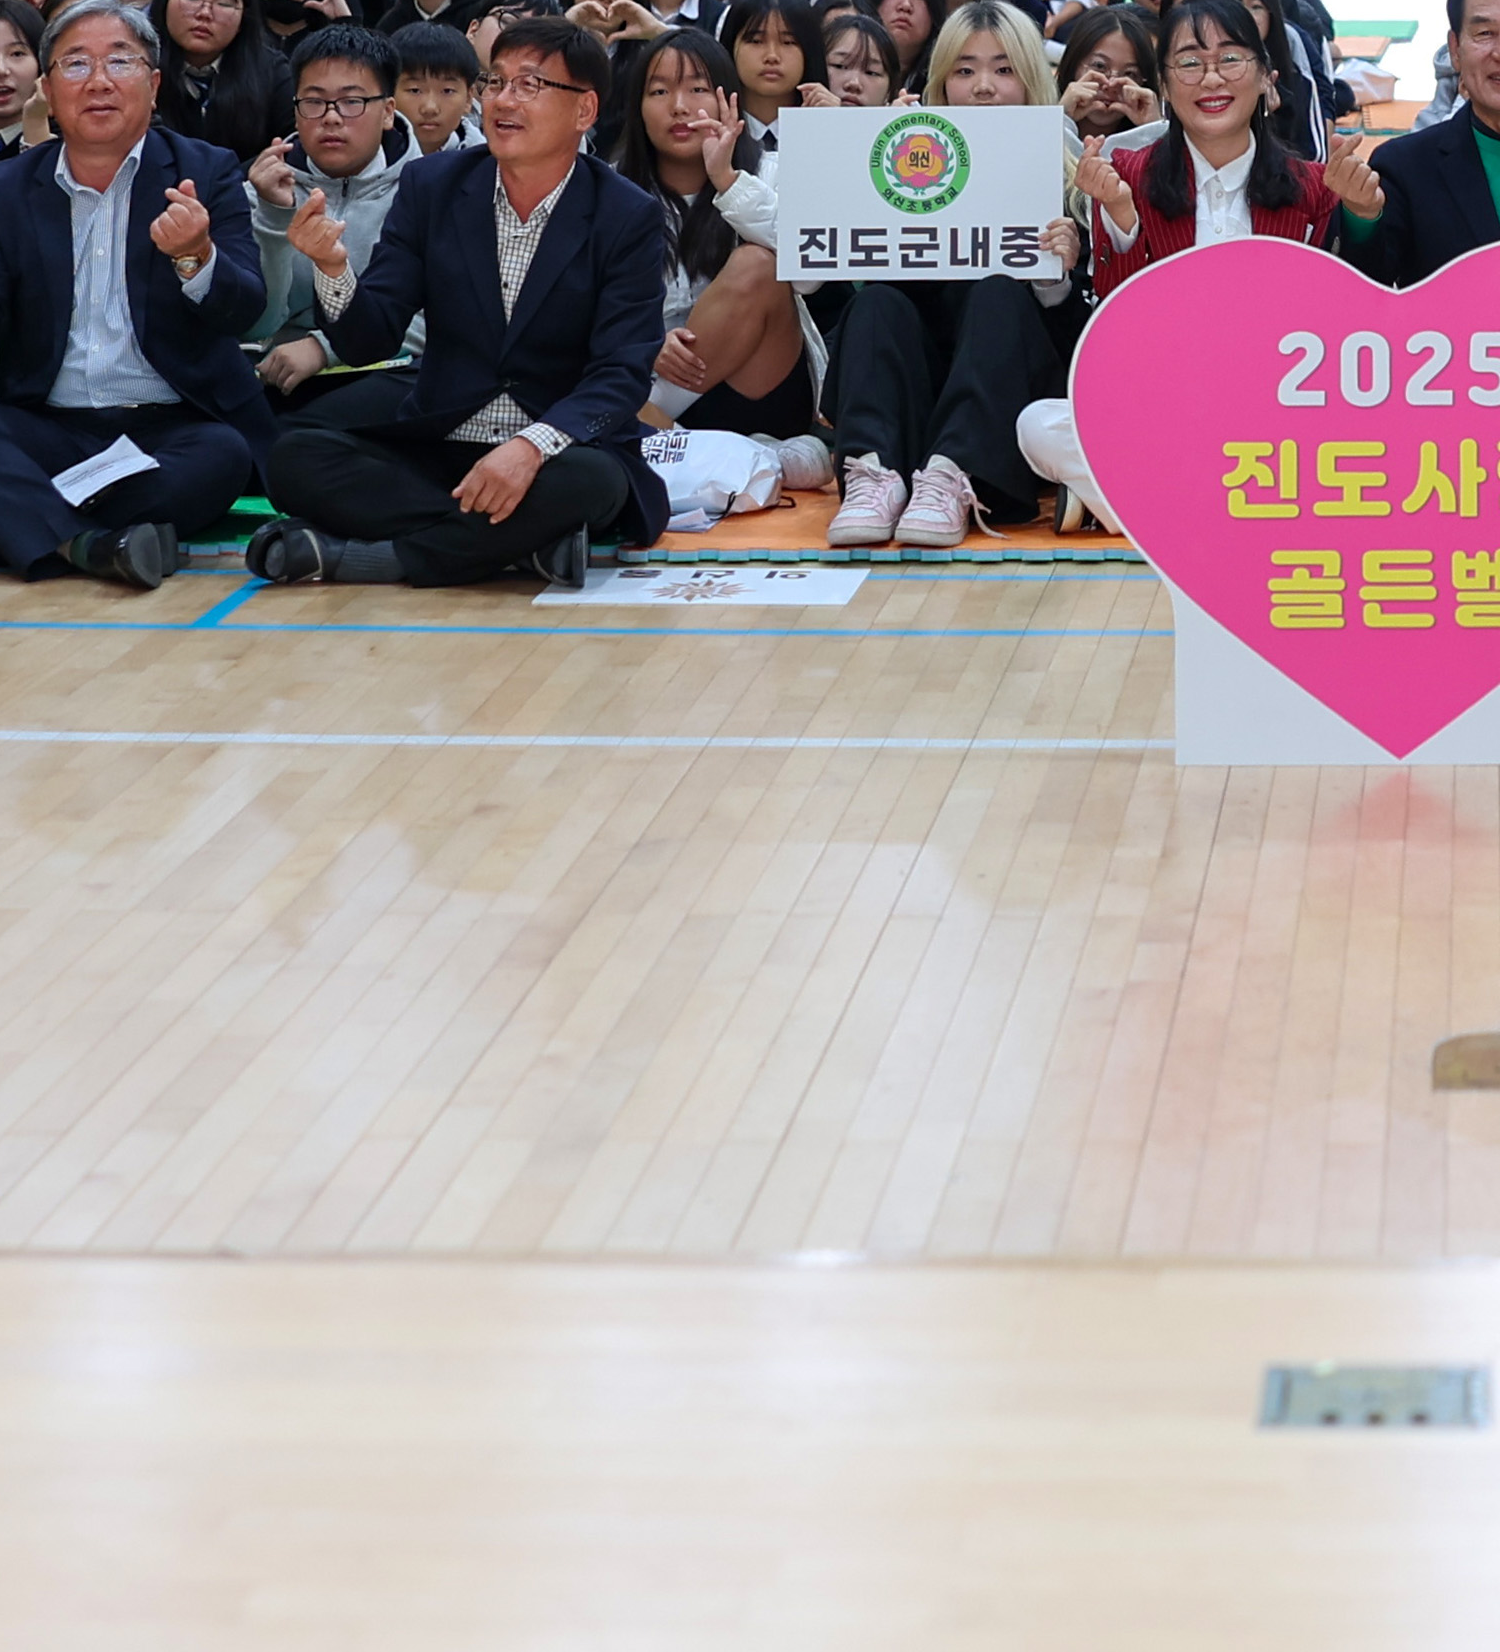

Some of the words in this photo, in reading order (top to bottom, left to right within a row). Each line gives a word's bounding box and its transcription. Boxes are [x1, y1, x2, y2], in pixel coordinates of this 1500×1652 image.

[871, 139, 885, 168] Uisin
[884, 115, 948, 138] Elementary
[948, 128, 969, 168] School
[909, 151, 930, 168] 의신
[799, 226, 1041, 268] 진도군내중
